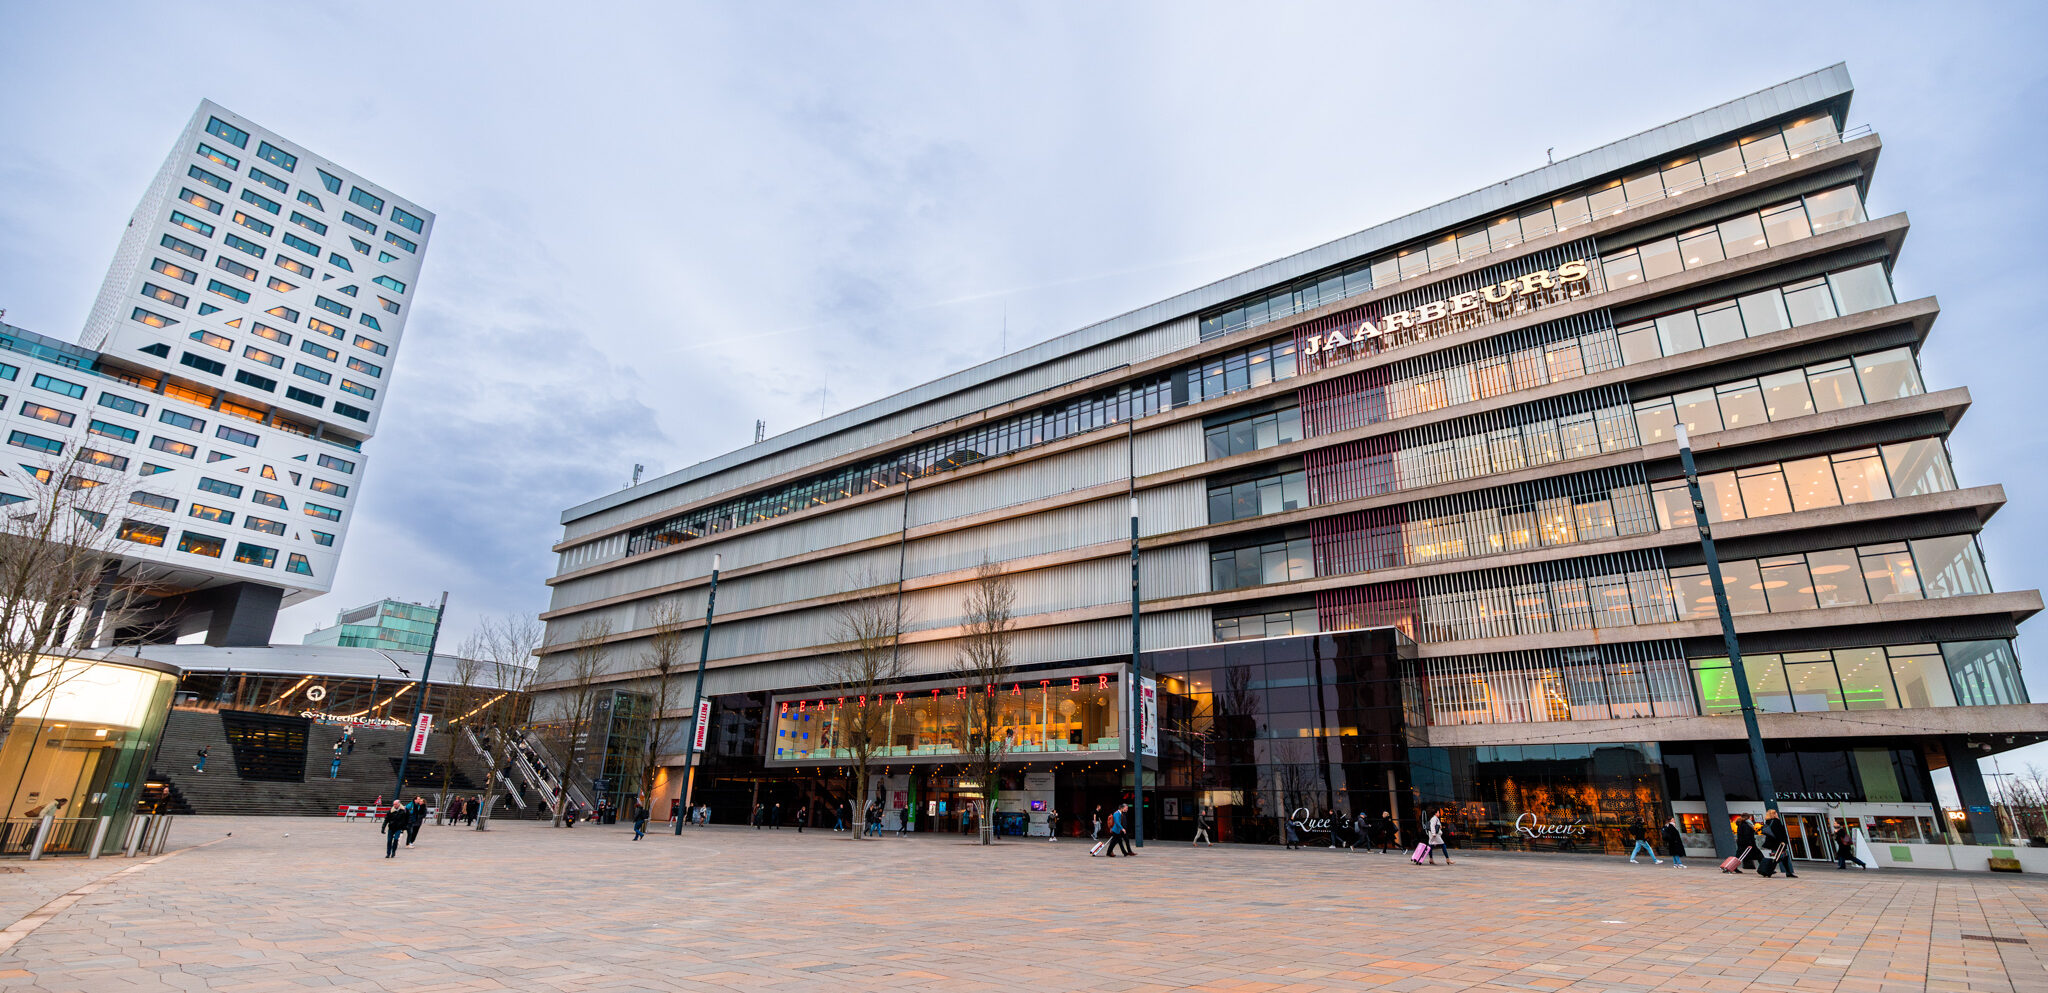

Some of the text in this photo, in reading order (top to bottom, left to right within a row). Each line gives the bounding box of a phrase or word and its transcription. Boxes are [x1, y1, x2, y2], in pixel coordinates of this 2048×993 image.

[1304, 258, 1589, 356] JAARBEURS
[781, 676, 1109, 714] BEATRIX THEATER
[695, 703, 709, 748] PRETTY WOMAN
[1775, 791, 1851, 801] ESTAURANT
[1291, 807, 1350, 832] Quee's
